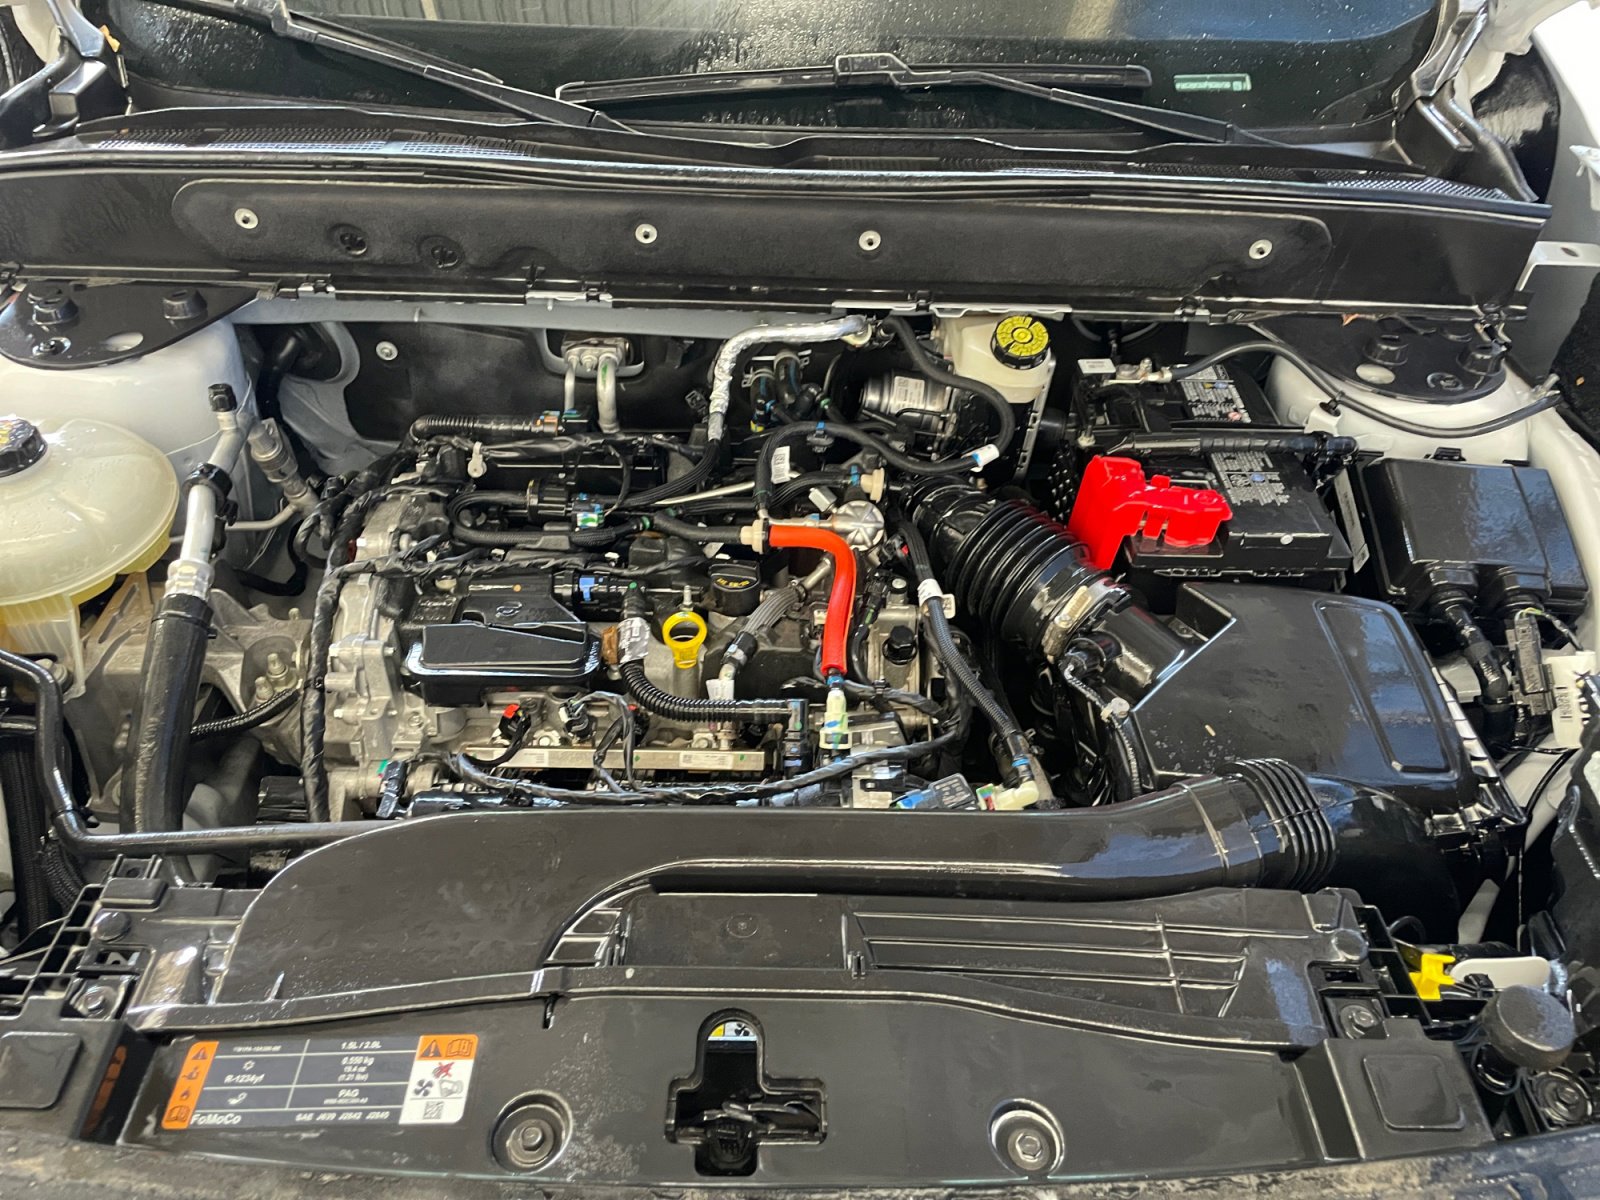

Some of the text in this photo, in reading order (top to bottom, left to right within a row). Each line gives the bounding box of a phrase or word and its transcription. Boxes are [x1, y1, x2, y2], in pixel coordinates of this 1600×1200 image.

[363, 1041, 382, 1049] 2.0L
[363, 1056, 375, 1066] kg
[224, 1073, 265, 1084] R-1234yf
[338, 1088, 360, 1098] PAG
[190, 1113, 242, 1125] FoMoCo
[295, 1113, 315, 1122] SAE
